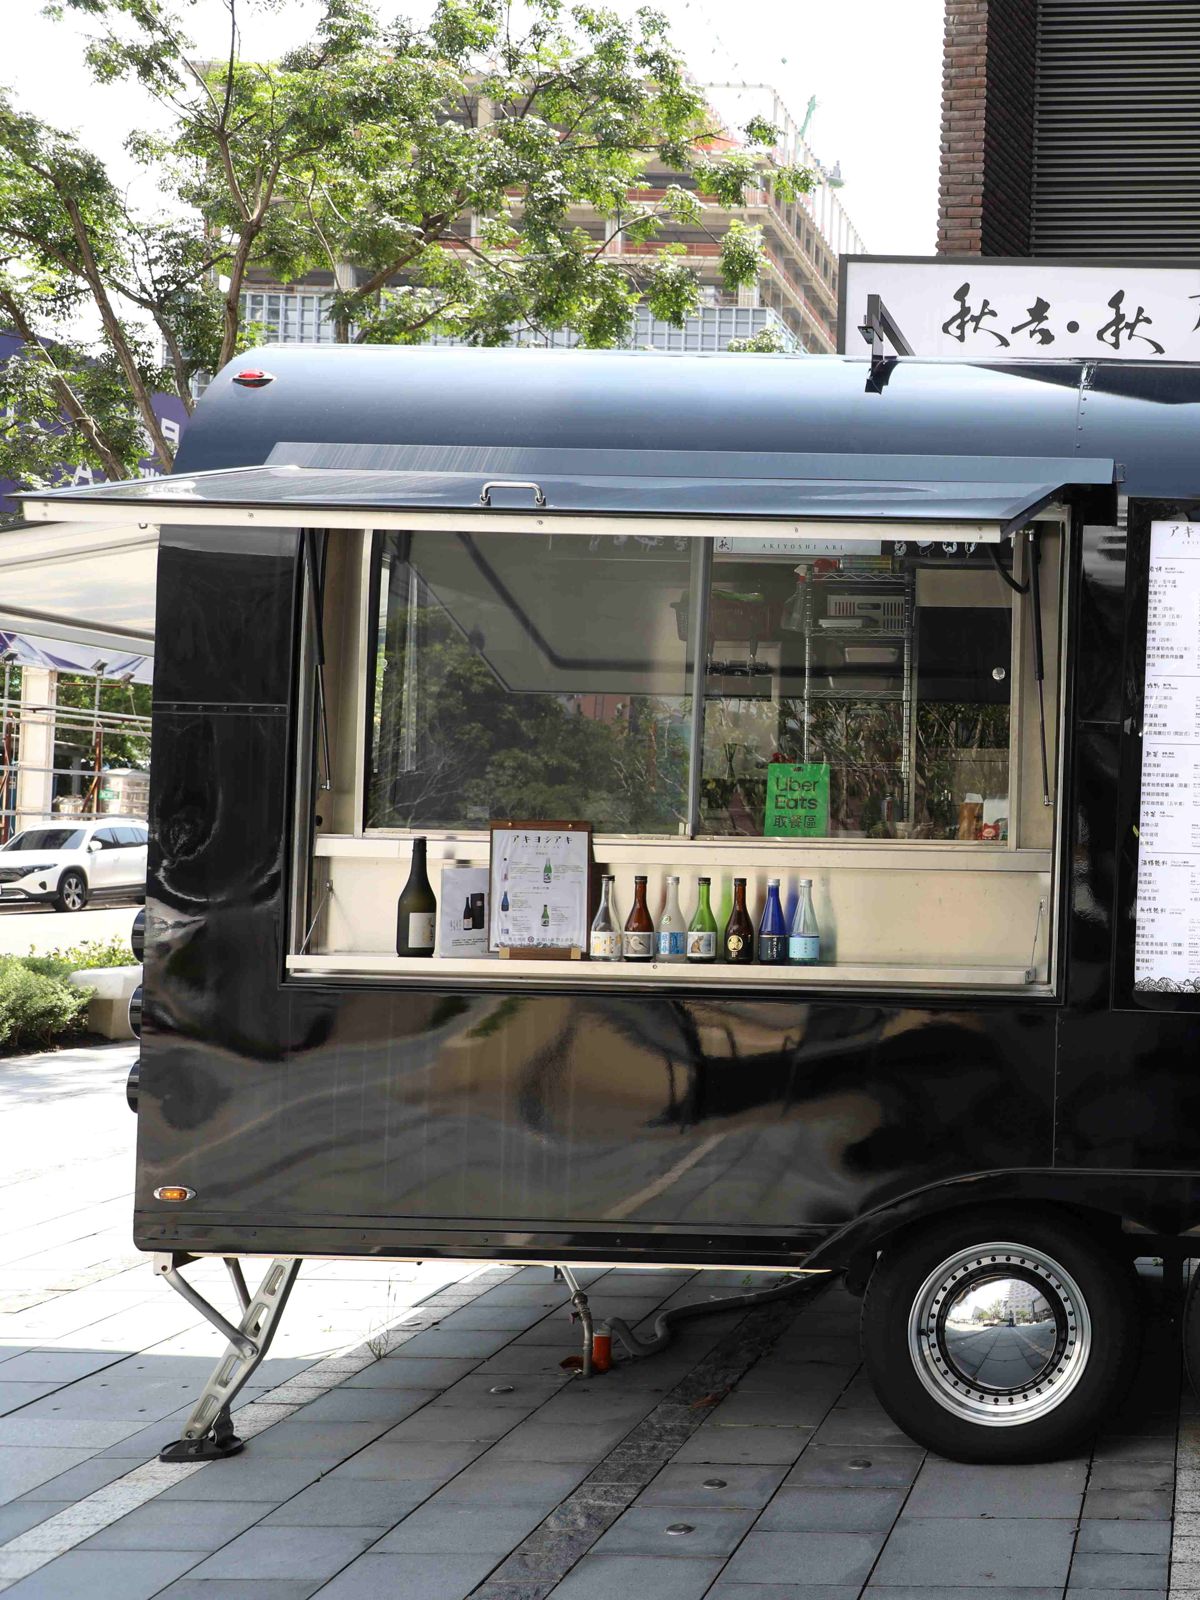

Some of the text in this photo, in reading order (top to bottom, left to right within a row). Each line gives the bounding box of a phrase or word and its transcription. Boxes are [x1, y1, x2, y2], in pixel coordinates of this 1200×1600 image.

[776, 778, 818, 791] Uber
[775, 795, 818, 810] Eats
[774, 816, 816, 828] 取餐區
[512, 834, 573, 845] アキヨシアキ
